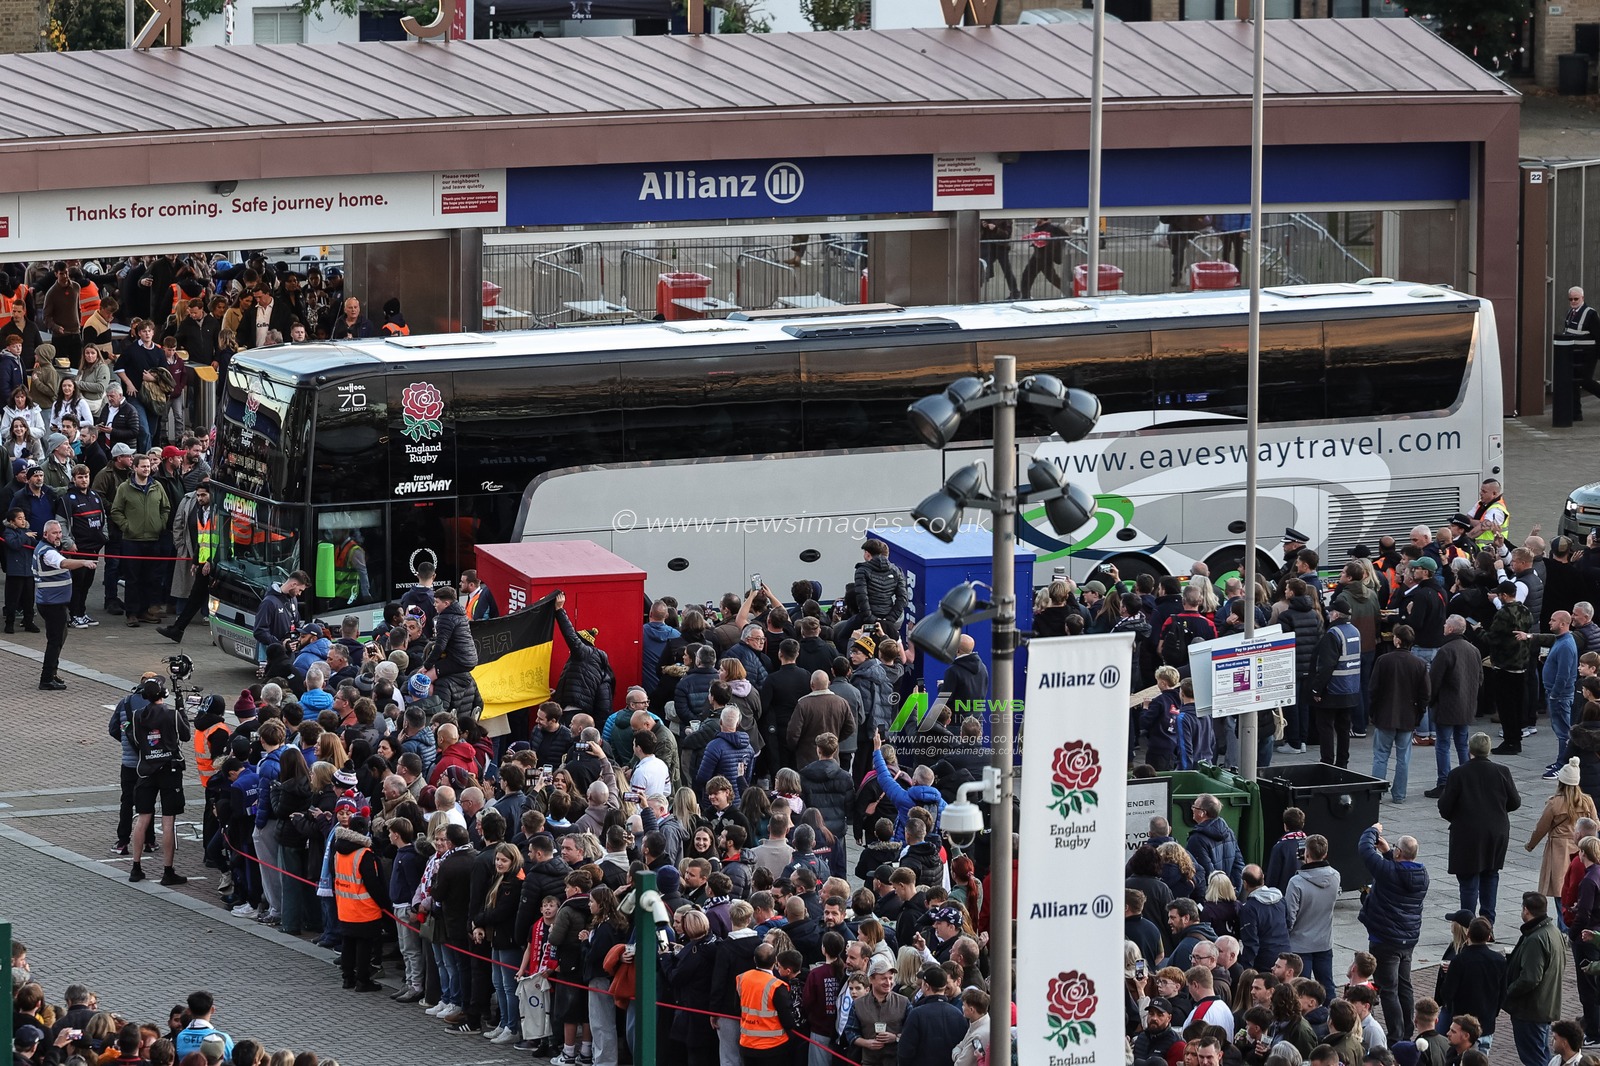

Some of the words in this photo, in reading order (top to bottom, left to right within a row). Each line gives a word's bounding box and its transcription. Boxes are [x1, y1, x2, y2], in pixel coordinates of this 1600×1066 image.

[638, 170, 757, 200] Allianz
[66, 204, 127, 221] Thanks
[131, 203, 153, 218] for
[158, 200, 222, 218] coming.
[232, 197, 268, 214] Safe
[272, 196, 334, 214] journey
[339, 192, 388, 208] home.
[338, 393, 367, 407] 70
[405, 442, 442, 454] England
[1045, 428, 1461, 474] www.eaveswaytravel.com
[410, 453, 438, 464] Rugby
[414, 473, 433, 481] travel
[394, 479, 452, 495] EAVESWAY
[1038, 672, 1096, 690] Allianz
[1127, 800, 1155, 808] ENDER
[1050, 821, 1096, 836] England
[1055, 837, 1090, 850] Rugby
[1030, 901, 1088, 920] Allianz
[1049, 1052, 1096, 1066] England
